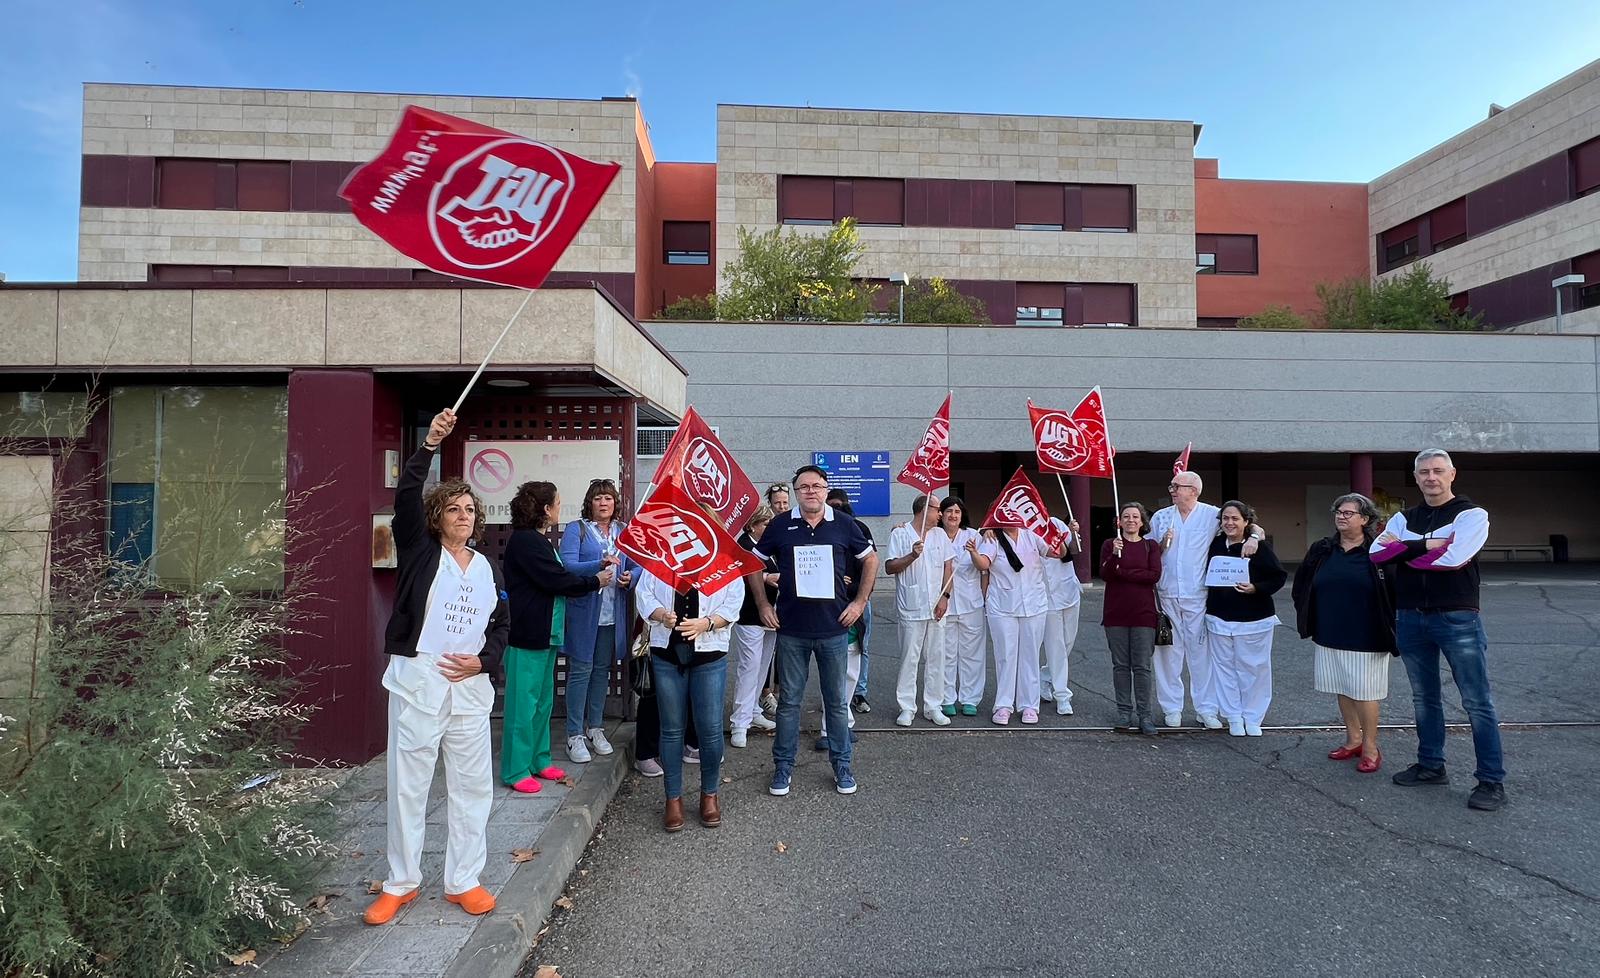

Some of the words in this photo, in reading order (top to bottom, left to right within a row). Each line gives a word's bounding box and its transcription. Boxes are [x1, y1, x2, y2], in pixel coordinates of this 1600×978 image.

[1041, 419, 1080, 448] UGT
[840, 454, 859, 463] IEN
[691, 441, 728, 494] UGT
[1008, 489, 1048, 532] UGT
[635, 507, 711, 566] UGT
[459, 584, 473, 593] NO
[458, 595, 471, 603] AL
[444, 602, 480, 616] CIERRE
[445, 613, 459, 623] DE
[459, 616, 472, 625] LA
[446, 624, 466, 635] ULE
